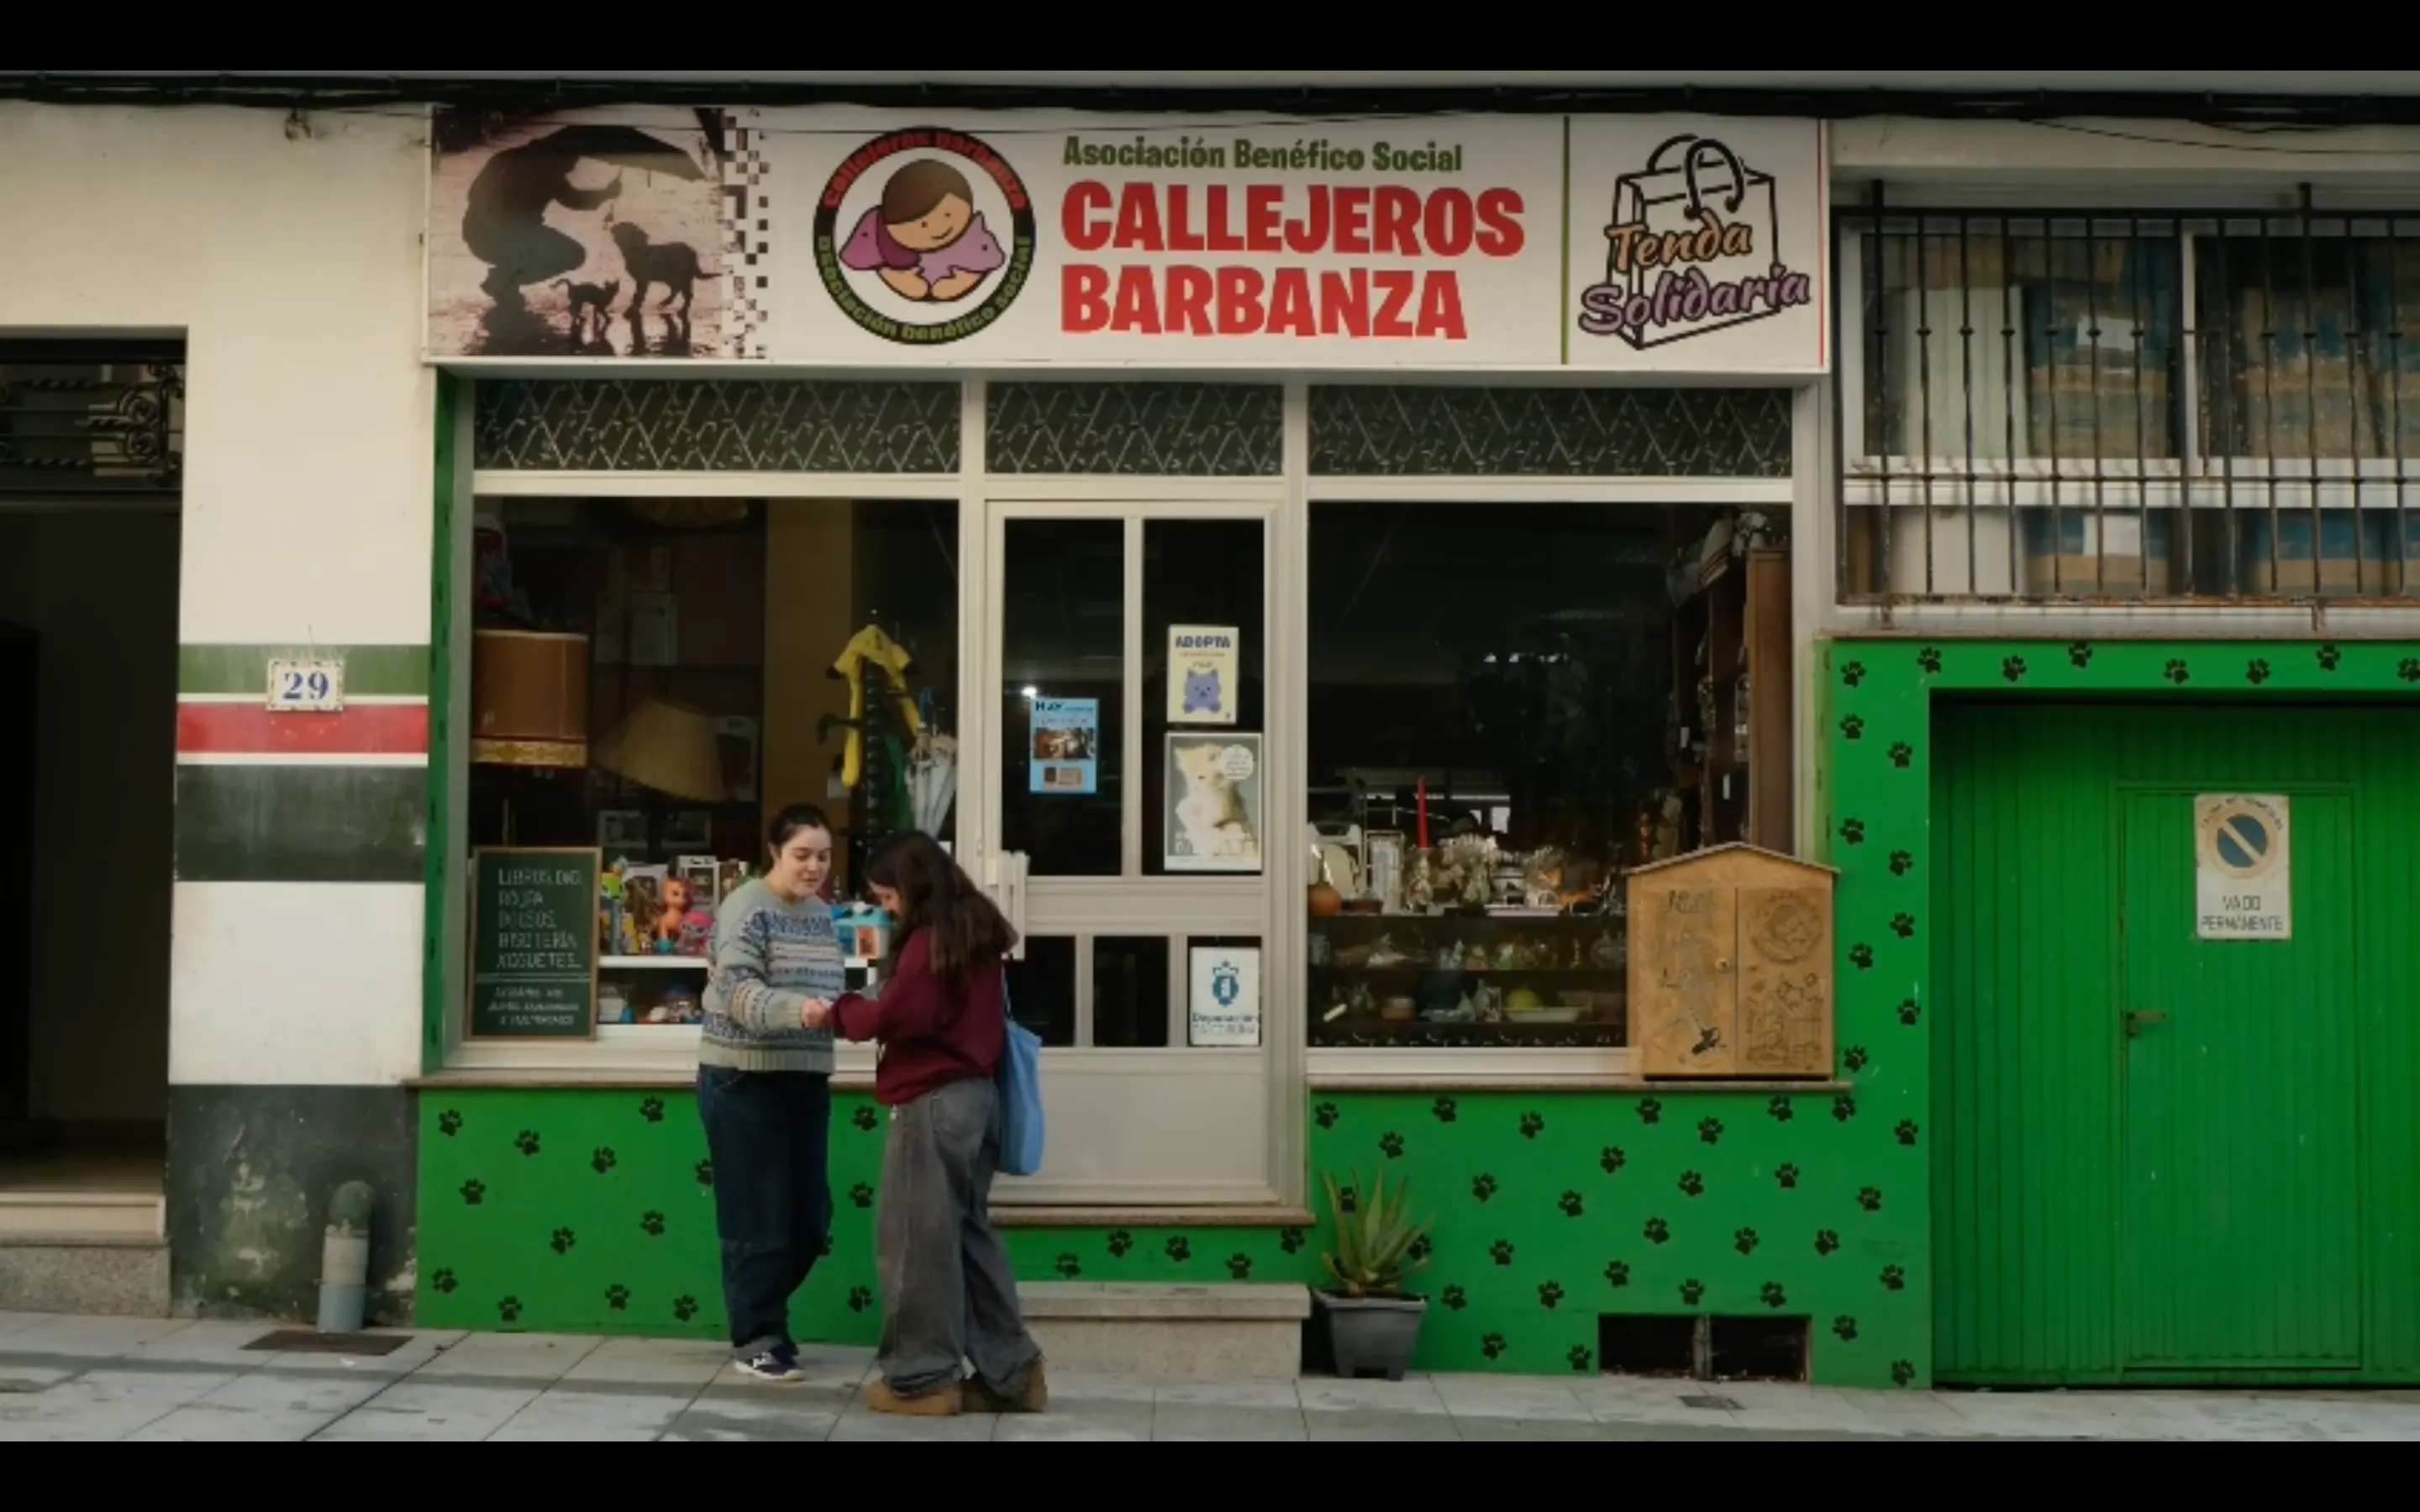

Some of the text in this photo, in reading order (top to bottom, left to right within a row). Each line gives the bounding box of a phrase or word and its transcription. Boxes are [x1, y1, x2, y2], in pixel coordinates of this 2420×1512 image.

[1063, 135, 1463, 172] Asociación Benéfico Social
[1060, 179, 1526, 258] CALLEJEROS
[1604, 208, 1752, 275] Tenda
[1060, 264, 1469, 340] BARBANZA
[1175, 635, 1231, 649] ADOPTA
[281, 671, 329, 700] 29
